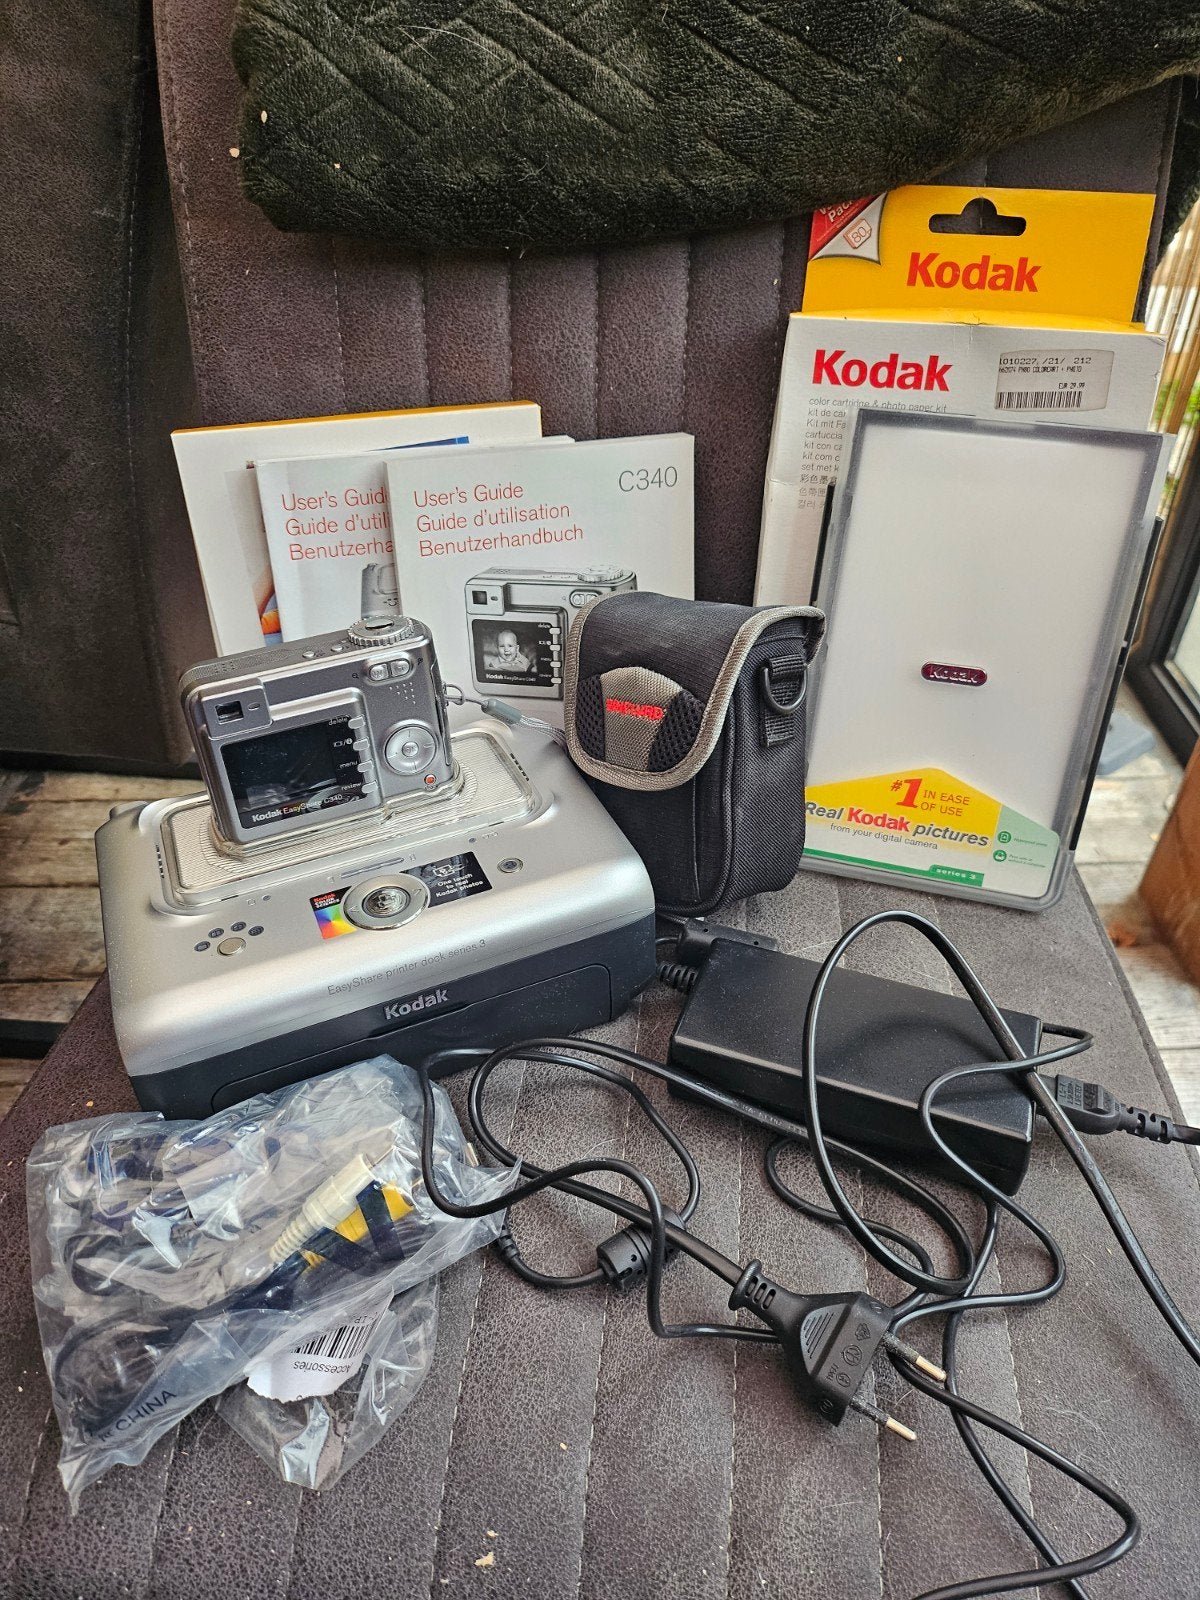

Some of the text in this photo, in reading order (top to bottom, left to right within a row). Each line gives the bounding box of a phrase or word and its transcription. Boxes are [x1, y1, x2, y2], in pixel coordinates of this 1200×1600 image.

[828, 201, 852, 222] Pac
[852, 226, 867, 243] 80
[906, 252, 1042, 293] Kodak
[1074, 357, 1092, 365] 212
[812, 349, 953, 392] Kodak
[808, 409, 818, 417] kit
[820, 409, 831, 417] de
[809, 397, 830, 405] color
[832, 399, 870, 408] cartridge
[881, 401, 906, 410] photo
[908, 404, 934, 412] paper
[936, 403, 948, 413] kit
[806, 419, 819, 428] Kit
[820, 419, 834, 428] mit
[805, 430, 843, 440] cartuccia
[804, 441, 814, 449] kit
[802, 452, 812, 460] kit
[801, 463, 814, 471] set
[618, 465, 679, 493] C340
[281, 487, 390, 511] User's Guid
[413, 482, 525, 508] User's Guide
[416, 503, 571, 533] Guide d'utilisation
[285, 517, 339, 537] Guide
[289, 537, 394, 561] Benutzerha
[419, 523, 584, 558] Benutzerhandbuch
[328, 716, 348, 726] delete
[340, 760, 358, 769] menu
[341, 782, 362, 791] review
[923, 790, 936, 799] IN
[940, 793, 970, 806] EASE
[252, 794, 343, 822] Kodak EasyShare C340
[920, 802, 963, 817] OF USE
[805, 801, 989, 847] Real Kodak pictures
[830, 823, 938, 850] from your digital camera
[437, 873, 473, 887] One touch
[936, 868, 966, 879] series
[436, 880, 484, 897] Kodak photos
[327, 939, 486, 996] EasyShare printer dock series 3
[384, 988, 449, 1020] Kodak
[115, 1390, 177, 1431] CHINA
